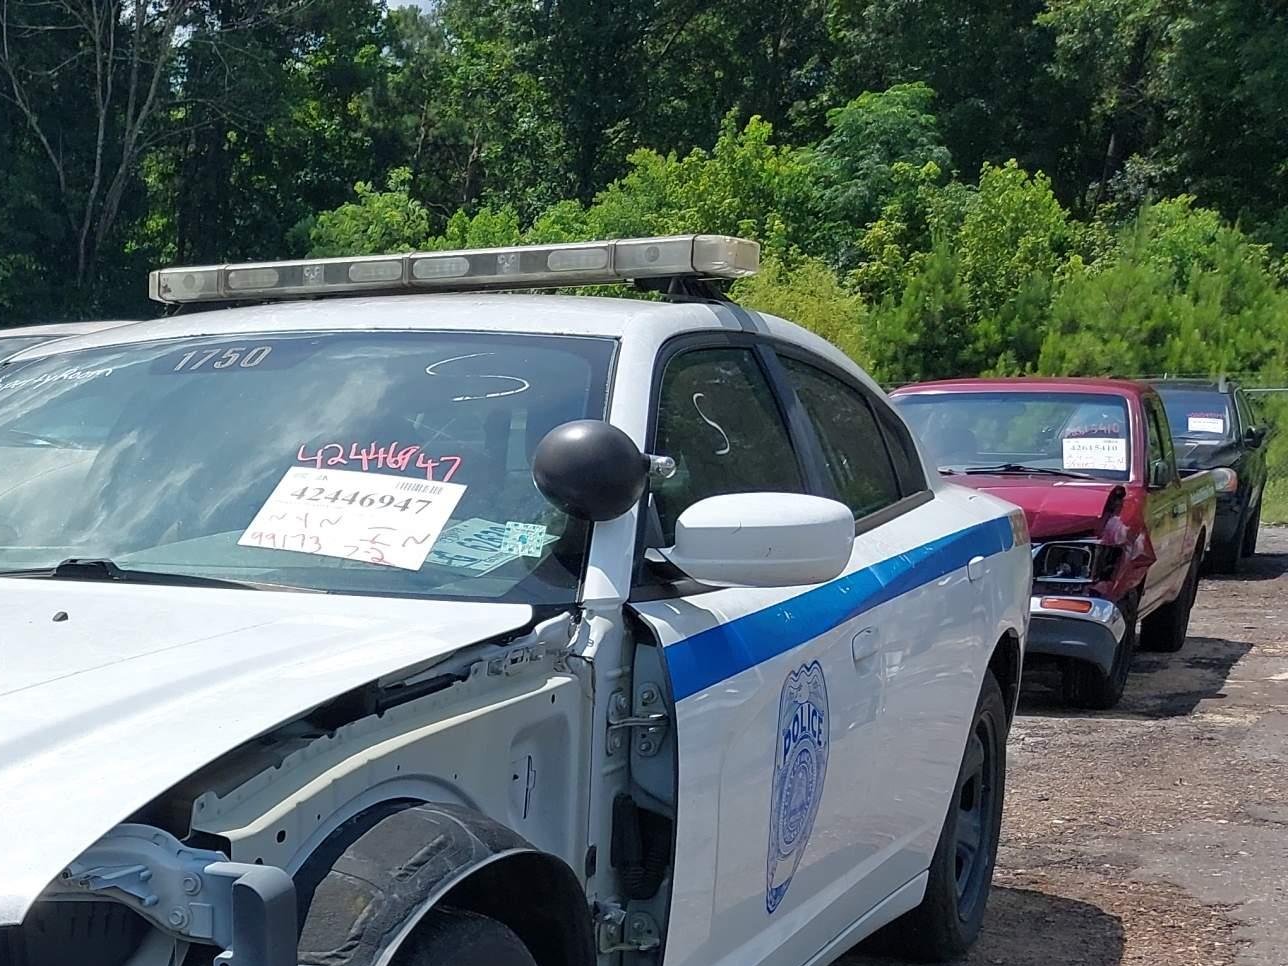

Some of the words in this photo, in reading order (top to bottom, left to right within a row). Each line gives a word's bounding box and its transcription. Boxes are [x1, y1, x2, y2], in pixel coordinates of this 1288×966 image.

[174, 345, 273, 372] 1750
[296, 441, 462, 482] 42446947
[289, 485, 433, 515] 42446947
[782, 703, 823, 765] POLICE
